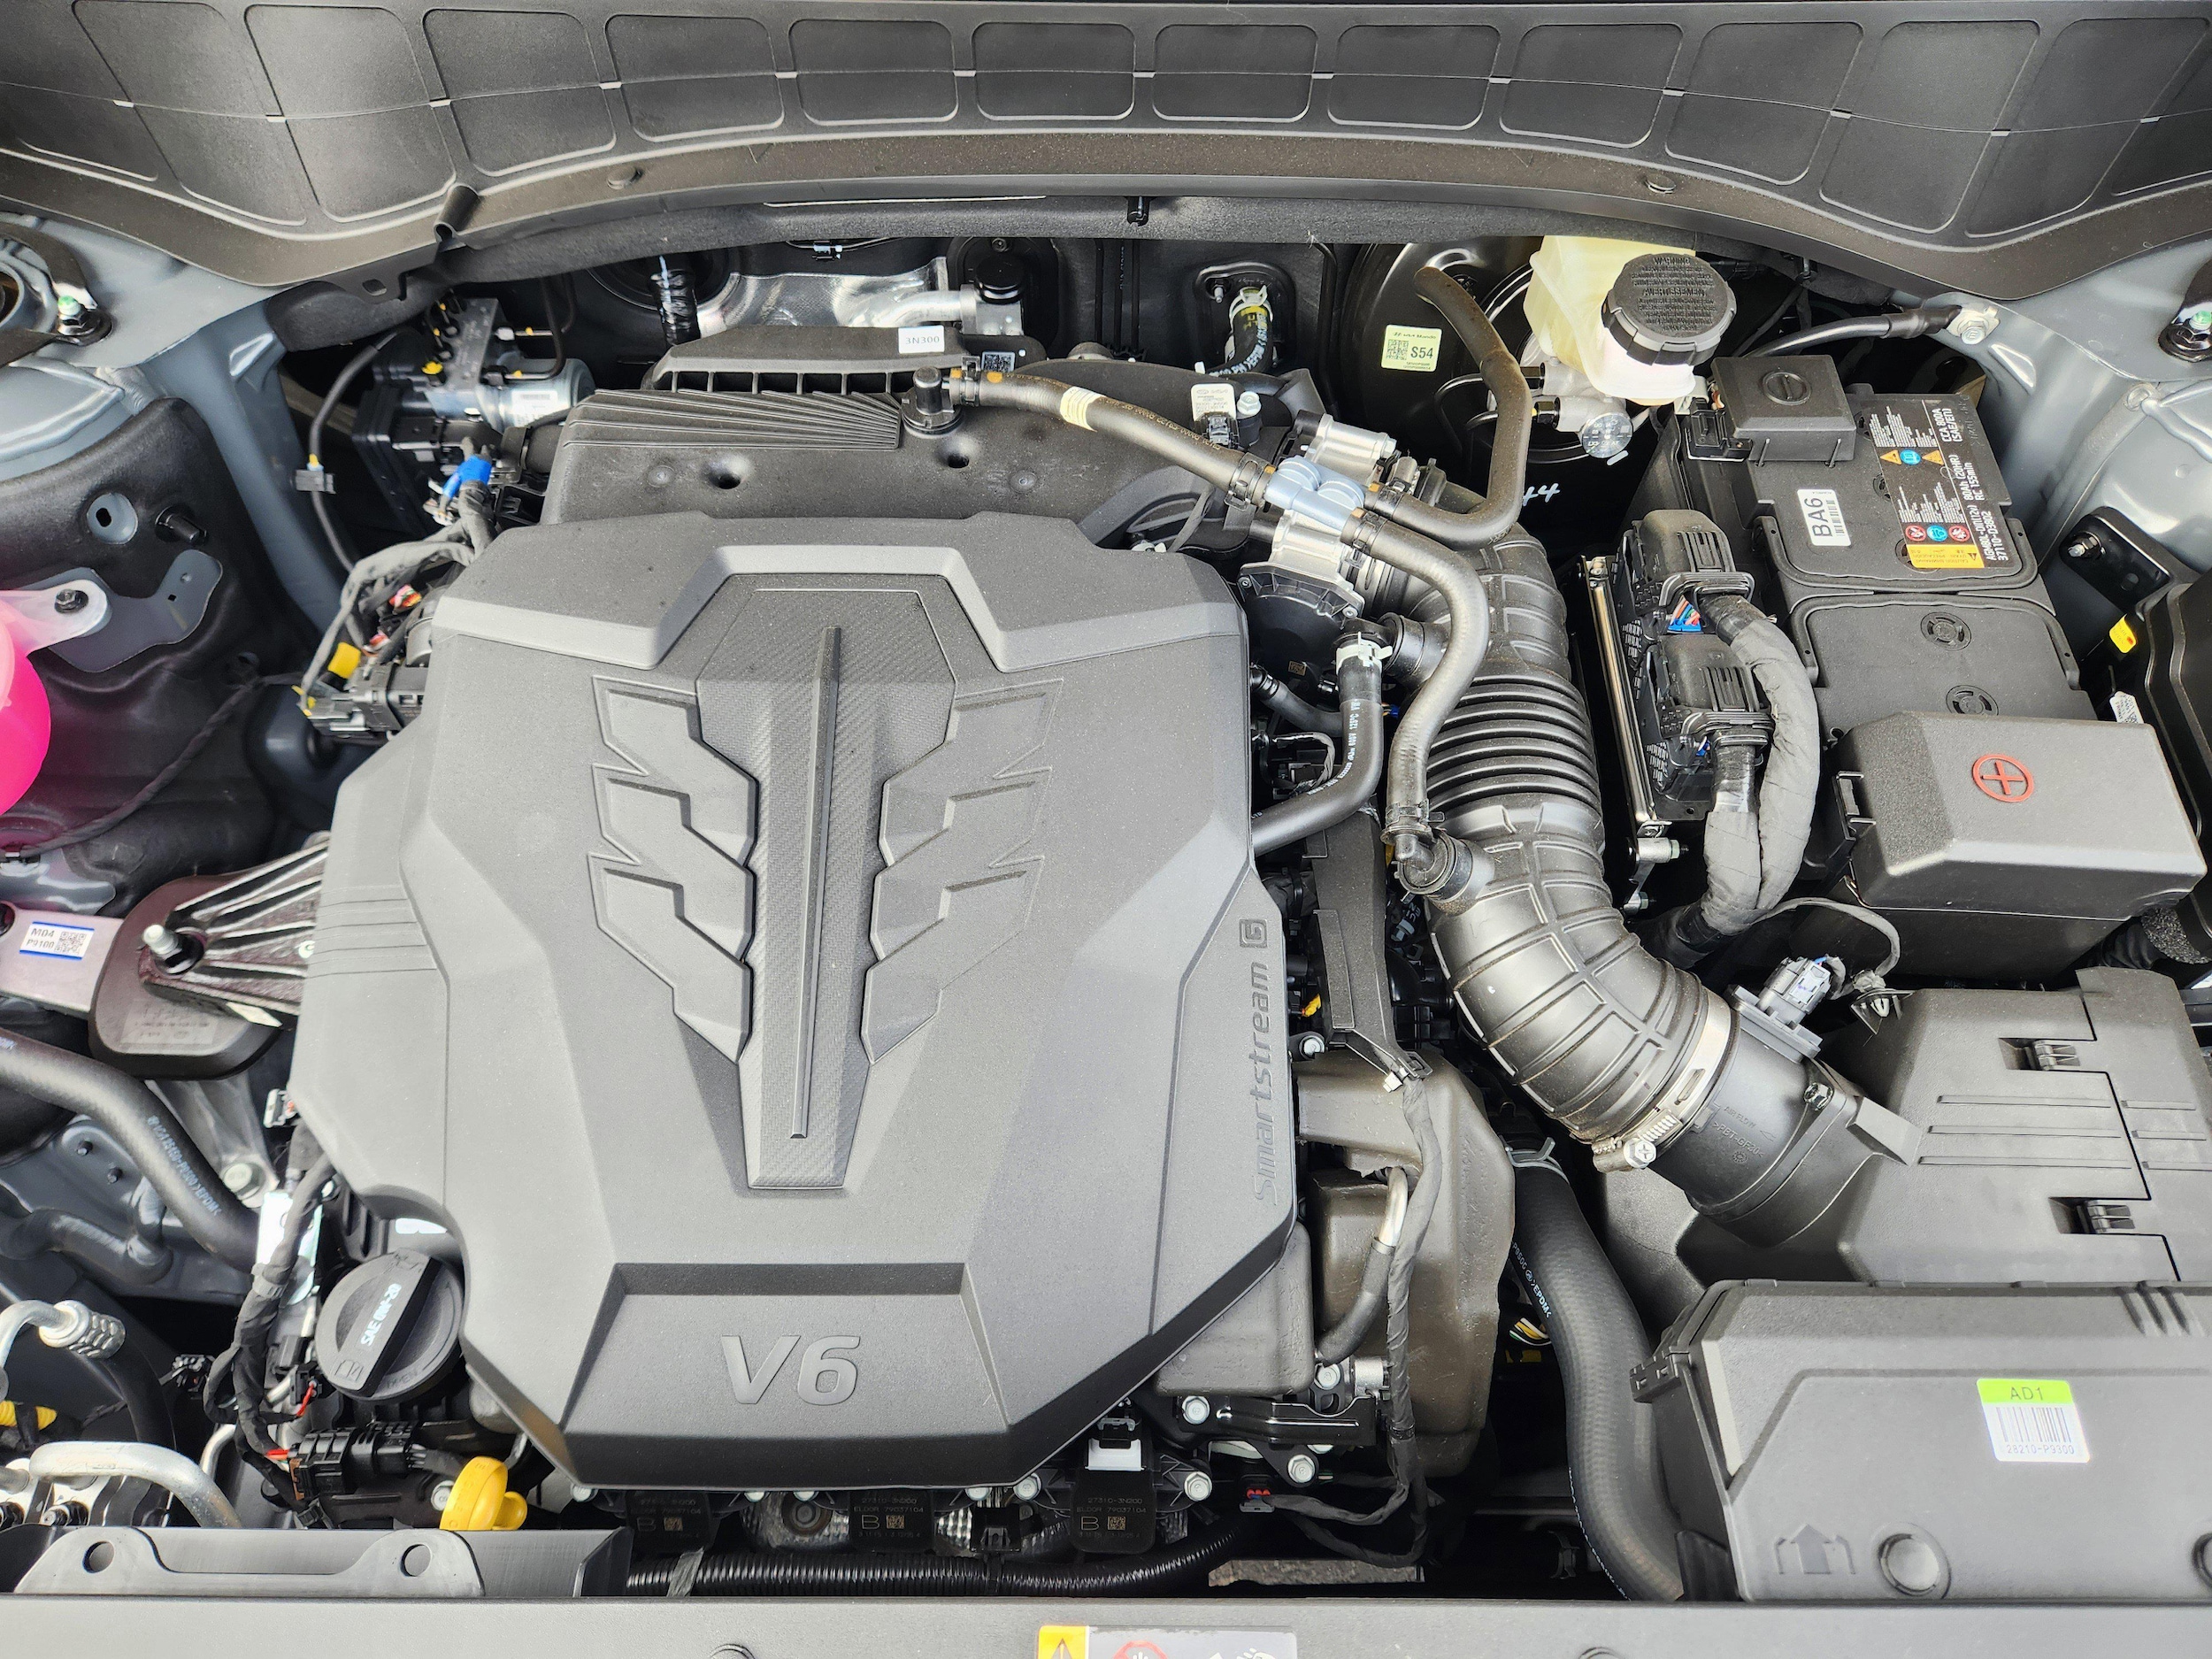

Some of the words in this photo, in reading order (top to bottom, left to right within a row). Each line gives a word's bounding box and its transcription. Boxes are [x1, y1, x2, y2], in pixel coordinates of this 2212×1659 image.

[905, 335, 941, 345] 3N300
[1410, 346, 1433, 359] S54
[1939, 427, 1952, 442] CCA
[1964, 462, 1981, 488] 155min
[1972, 488, 1985, 501] RC
[1804, 497, 1833, 537] BA6
[31, 928, 55, 938] M04
[1248, 960, 1279, 1207] Smartstream
[360, 1319, 383, 1347] SAE
[721, 1334, 861, 1406] V6
[2010, 1386, 2044, 1401] AD1
[861, 1515, 880, 1530] B
[1080, 1516, 1100, 1531] B
